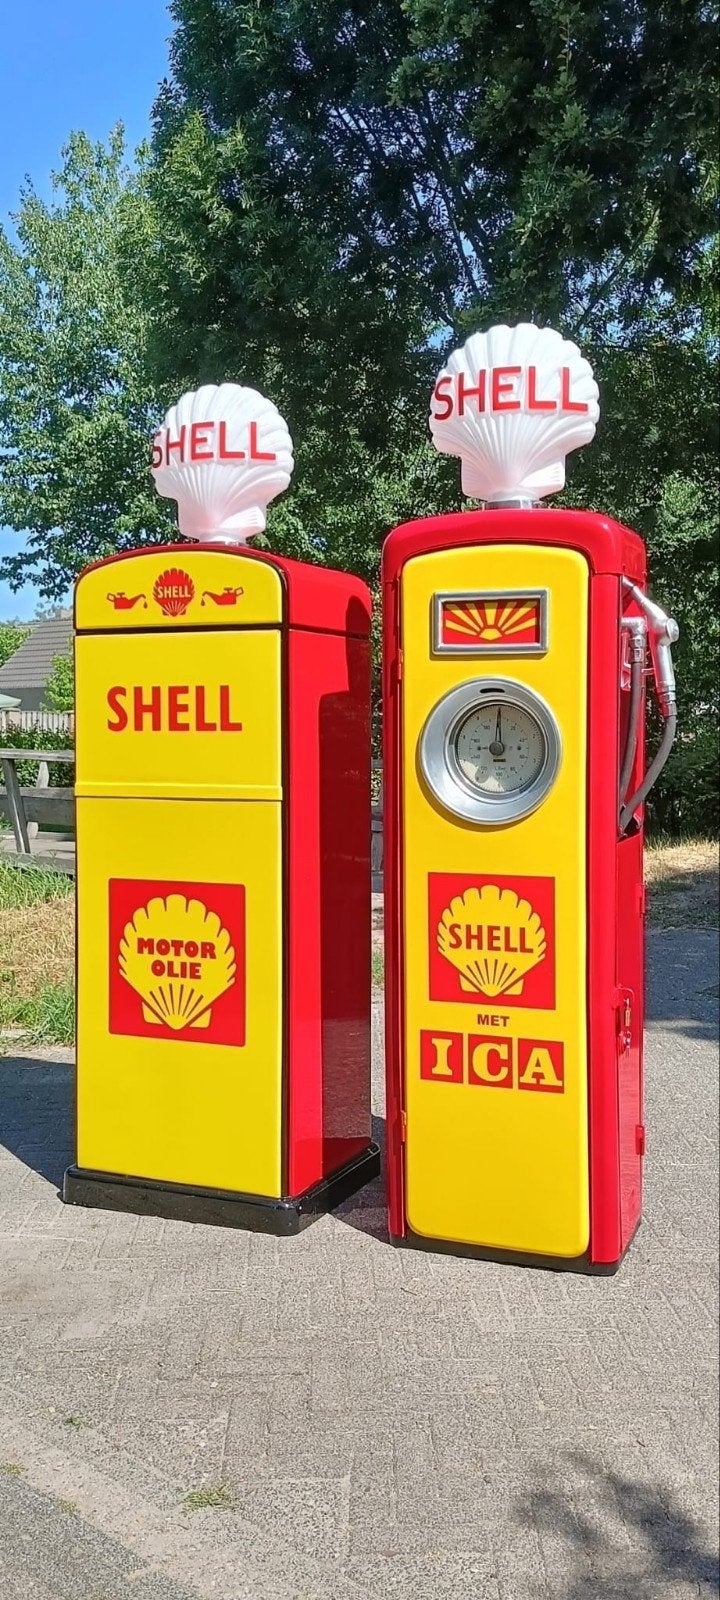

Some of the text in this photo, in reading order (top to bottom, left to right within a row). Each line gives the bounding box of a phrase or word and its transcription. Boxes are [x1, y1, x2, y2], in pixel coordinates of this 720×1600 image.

[434, 366, 588, 421] SHELL
[152, 422, 276, 468] SHELL
[157, 585, 191, 599] SHELL
[107, 684, 243, 734] SHELL
[137, 937, 217, 960] MOTOR
[448, 923, 534, 954] SHELL
[151, 959, 202, 980] OLIE
[477, 1014, 510, 1027] MET
[431, 1037, 563, 1087] ICA
